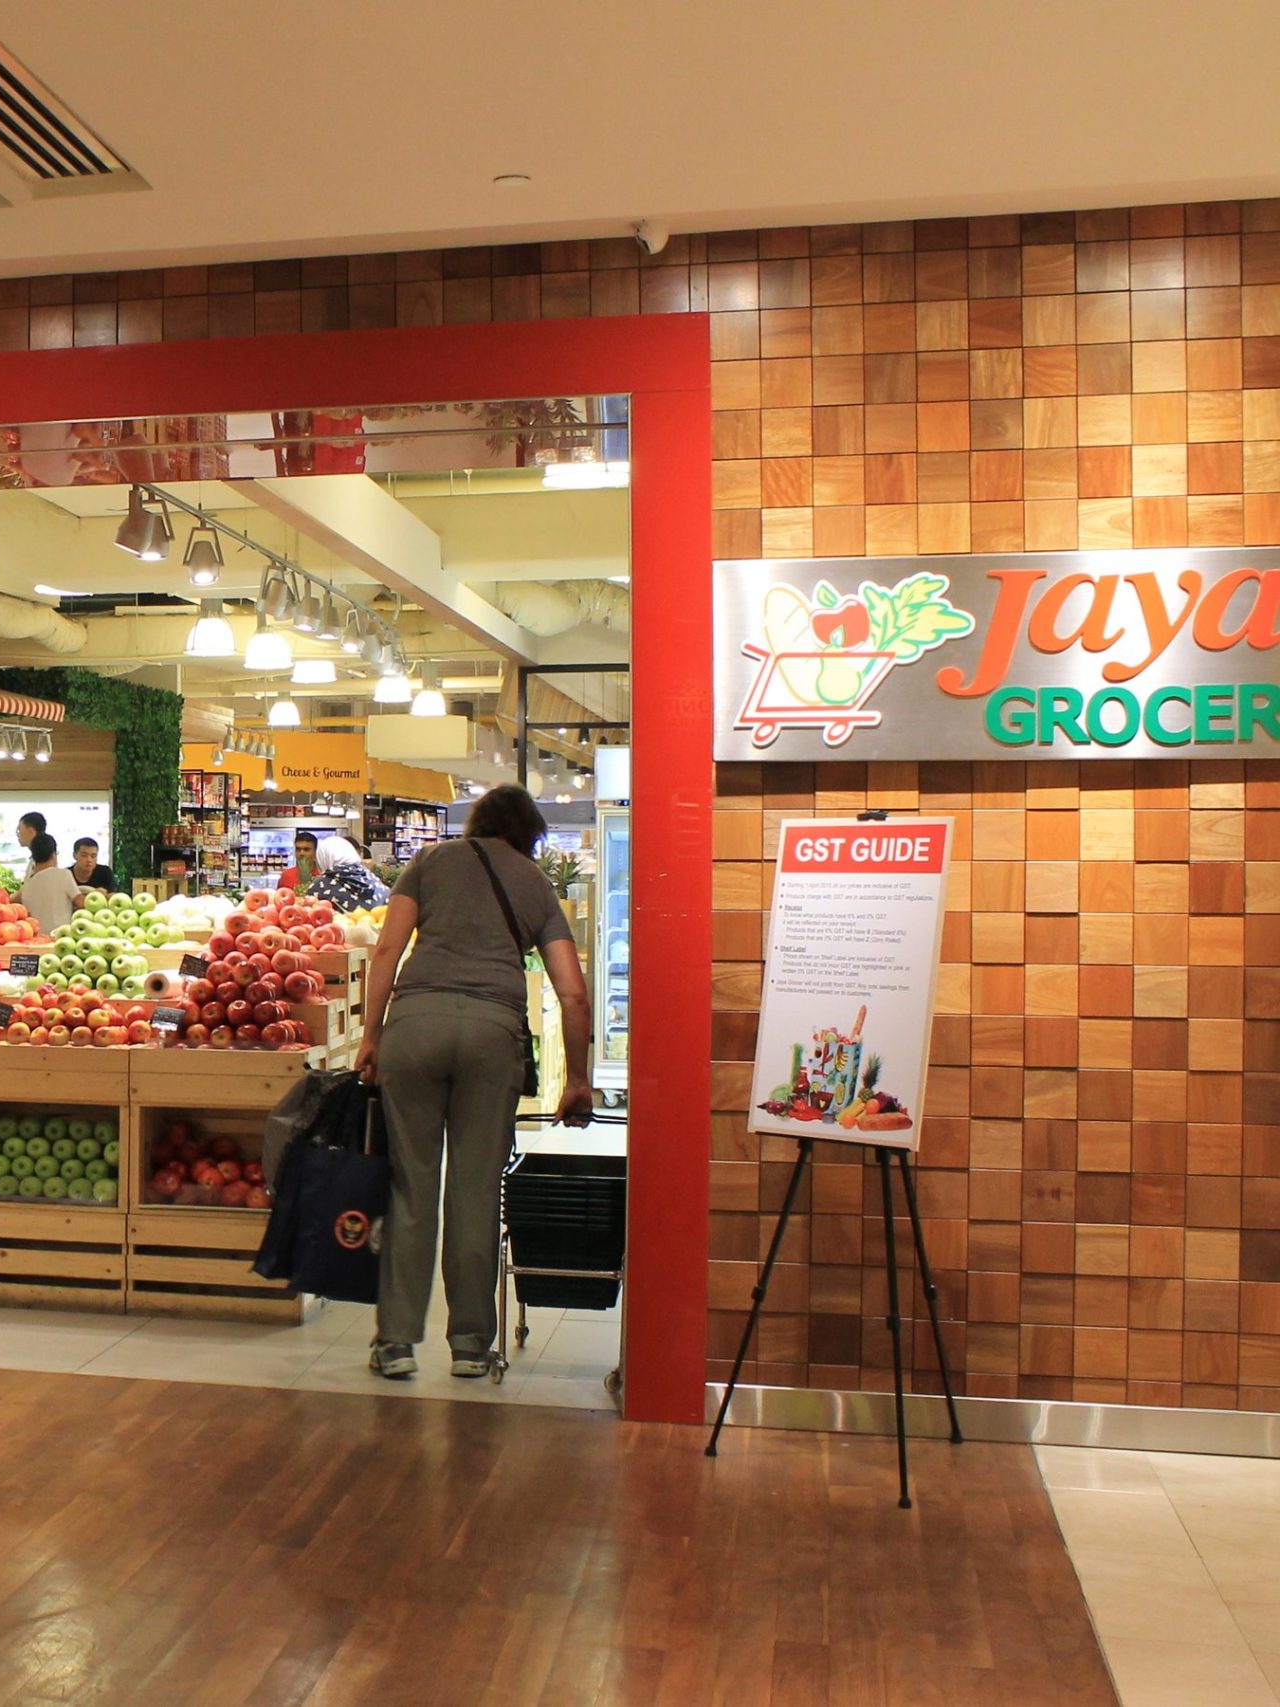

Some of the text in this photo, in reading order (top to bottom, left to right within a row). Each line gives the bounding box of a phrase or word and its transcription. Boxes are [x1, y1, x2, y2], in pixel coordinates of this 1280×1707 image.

[936, 567, 1280, 696] Jaya
[984, 682, 1280, 746] GROCER
[281, 766, 360, 780] Cheese & Gourmet
[795, 837, 931, 862] GST GUIDE
